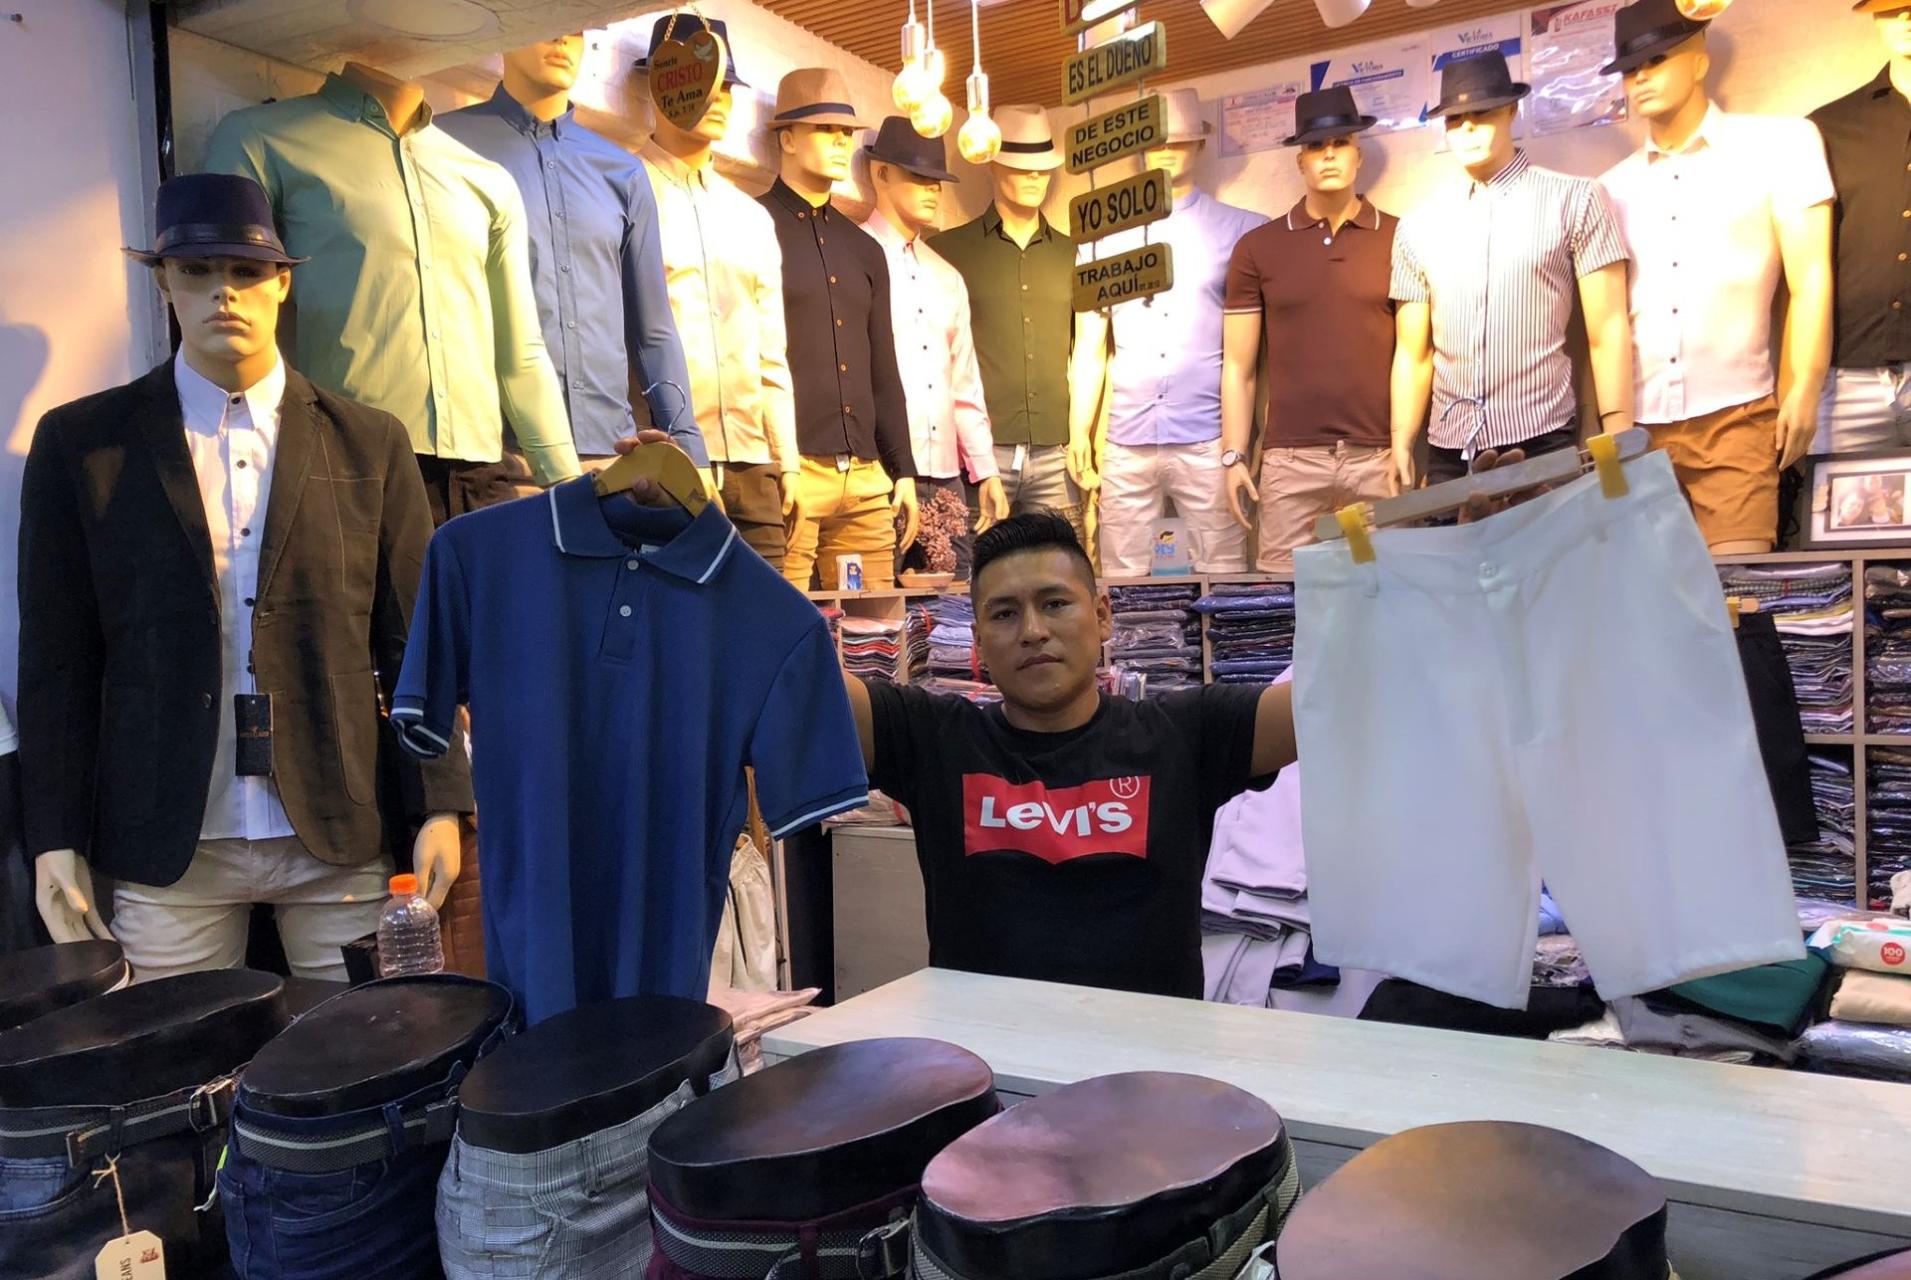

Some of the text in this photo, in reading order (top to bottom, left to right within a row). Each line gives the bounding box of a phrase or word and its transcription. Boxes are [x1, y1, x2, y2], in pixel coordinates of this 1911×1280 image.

[1451, 43, 1500, 58] CERTIFICADO
[657, 62, 704, 93] CRISTO
[1069, 60, 1085, 95] ES
[1088, 53, 1103, 88] EL
[661, 88, 704, 109] Te Ama
[1075, 103, 1149, 145] DE ESTE
[1072, 125, 1155, 168] NEGOCIO
[1077, 179, 1157, 234] YO SOLO
[1077, 252, 1157, 286] TRABAJO
[1097, 273, 1138, 302] AQUÍ
[1883, 946, 1903, 957] 100
